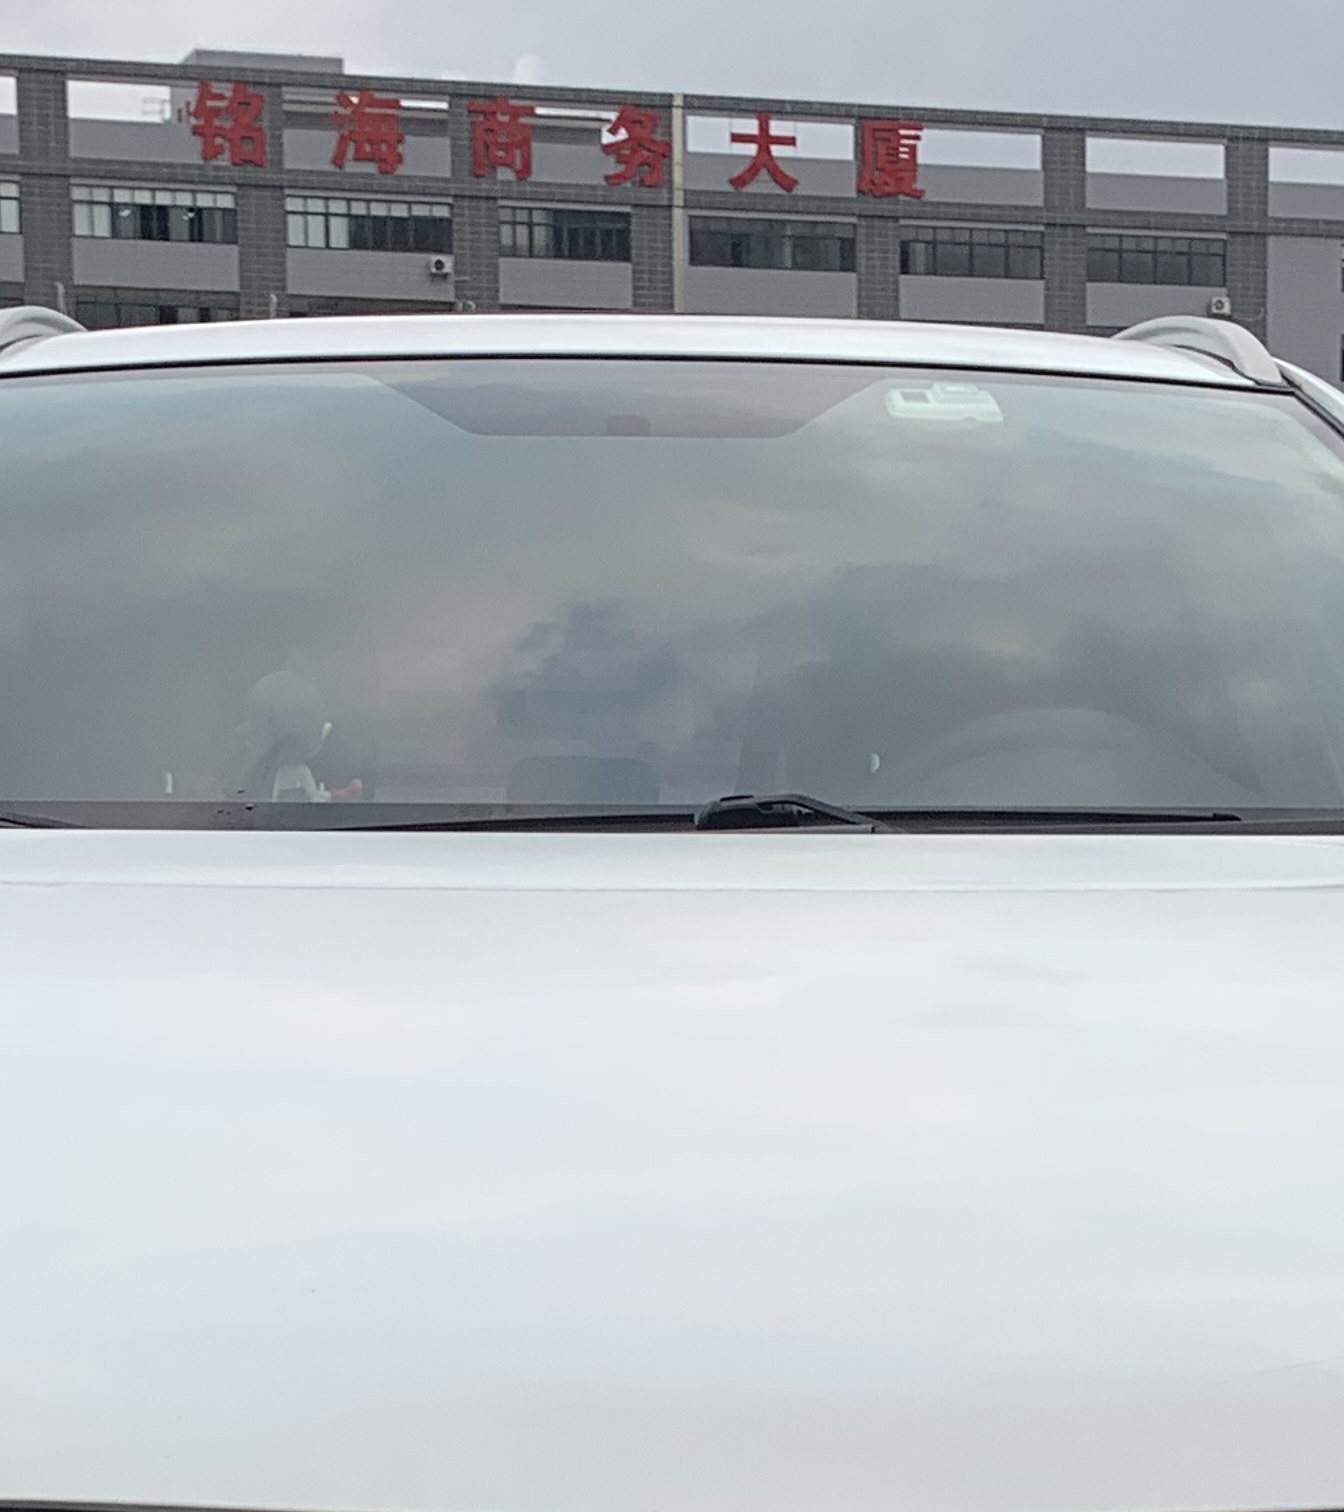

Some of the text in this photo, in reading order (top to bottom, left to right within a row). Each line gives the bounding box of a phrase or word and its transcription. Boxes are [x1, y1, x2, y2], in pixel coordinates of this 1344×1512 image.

[189, 80, 925, 199] 铭海商务大厦
